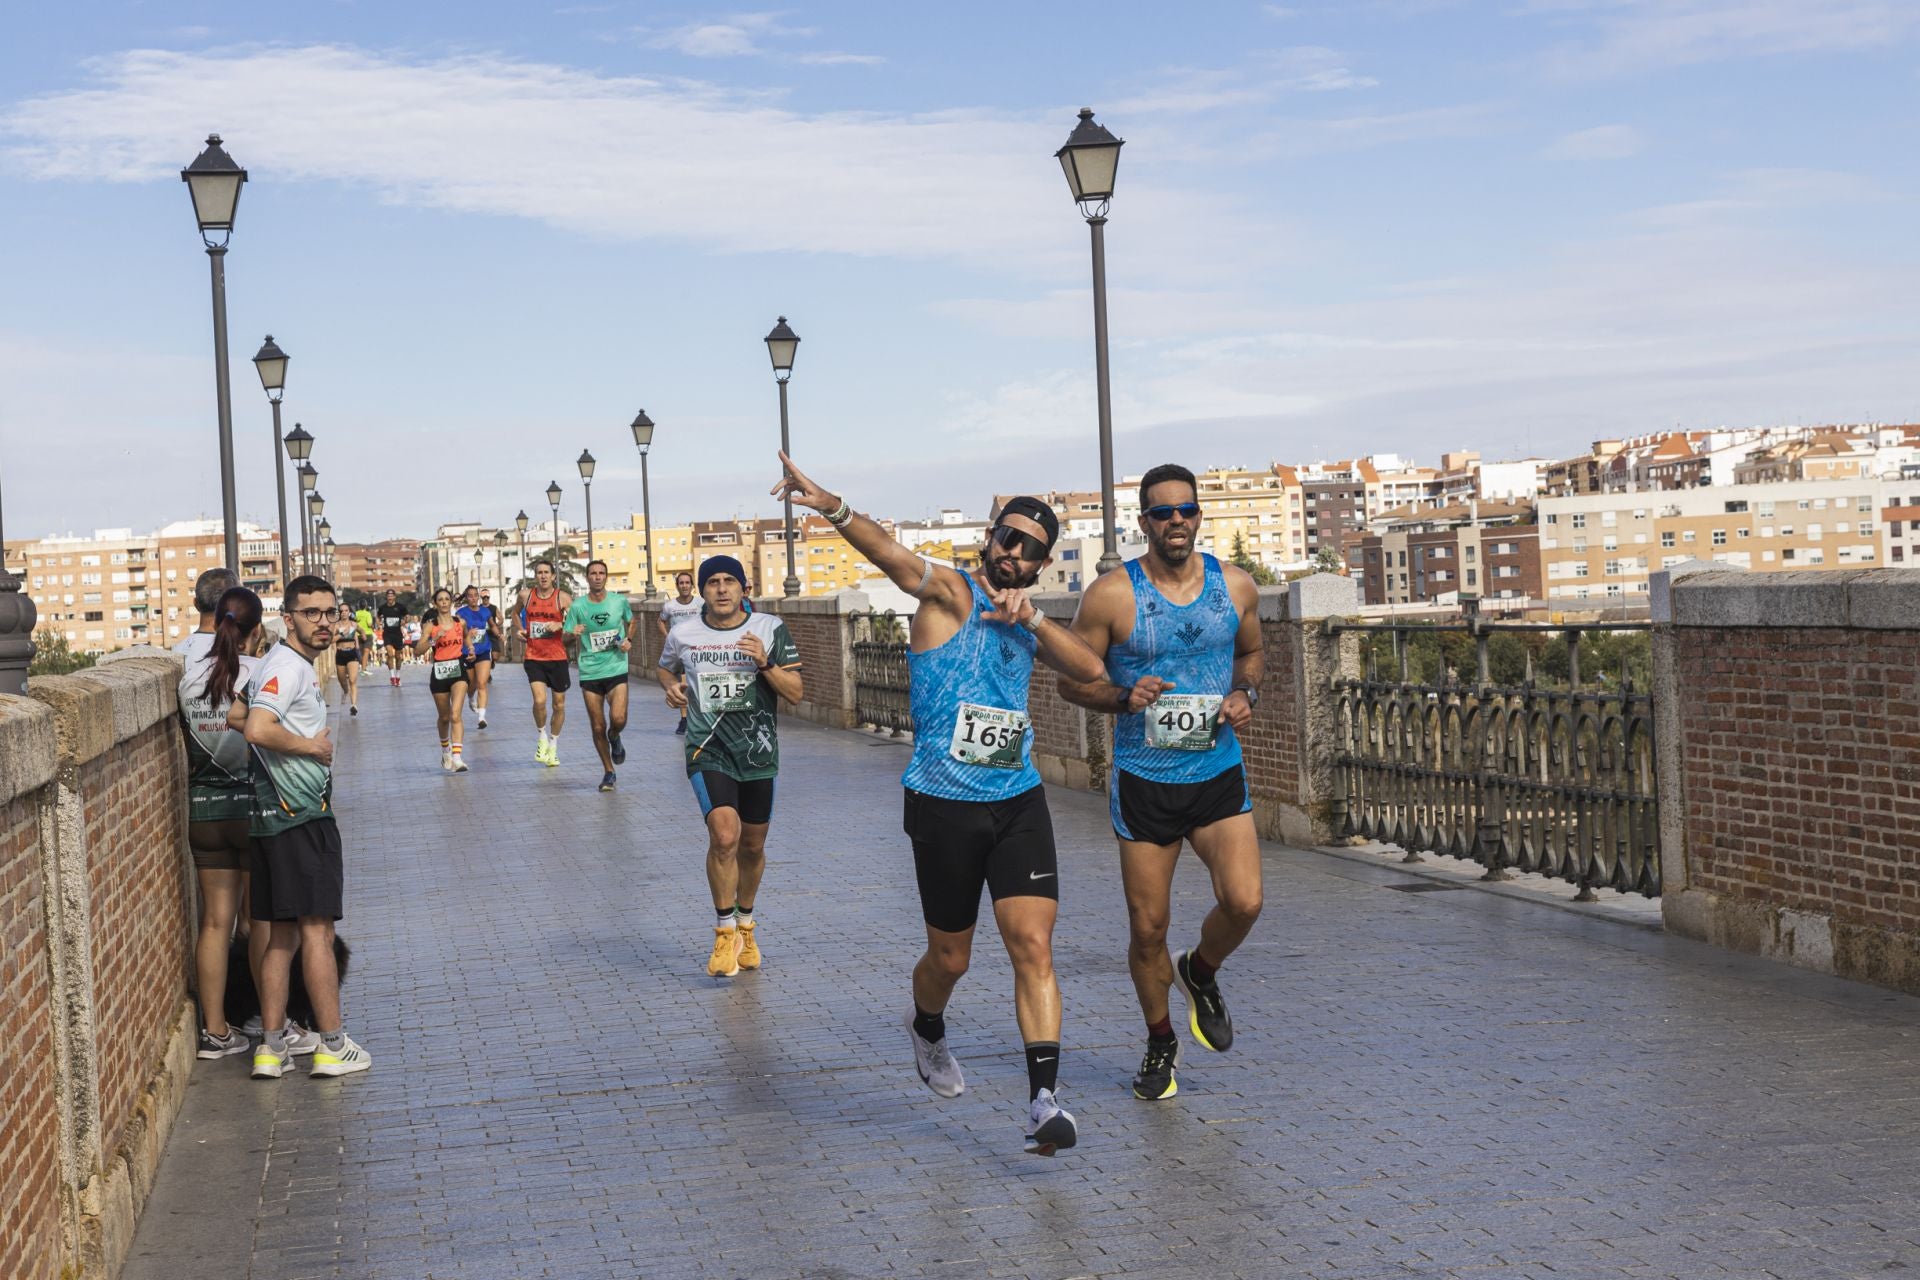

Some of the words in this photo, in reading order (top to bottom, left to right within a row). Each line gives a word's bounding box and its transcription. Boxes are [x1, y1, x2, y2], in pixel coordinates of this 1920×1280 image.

[691, 651, 729, 667] GUARDIA
[709, 683, 746, 699] 215
[1158, 711, 1211, 732] 401
[962, 722, 1022, 751] 1657
